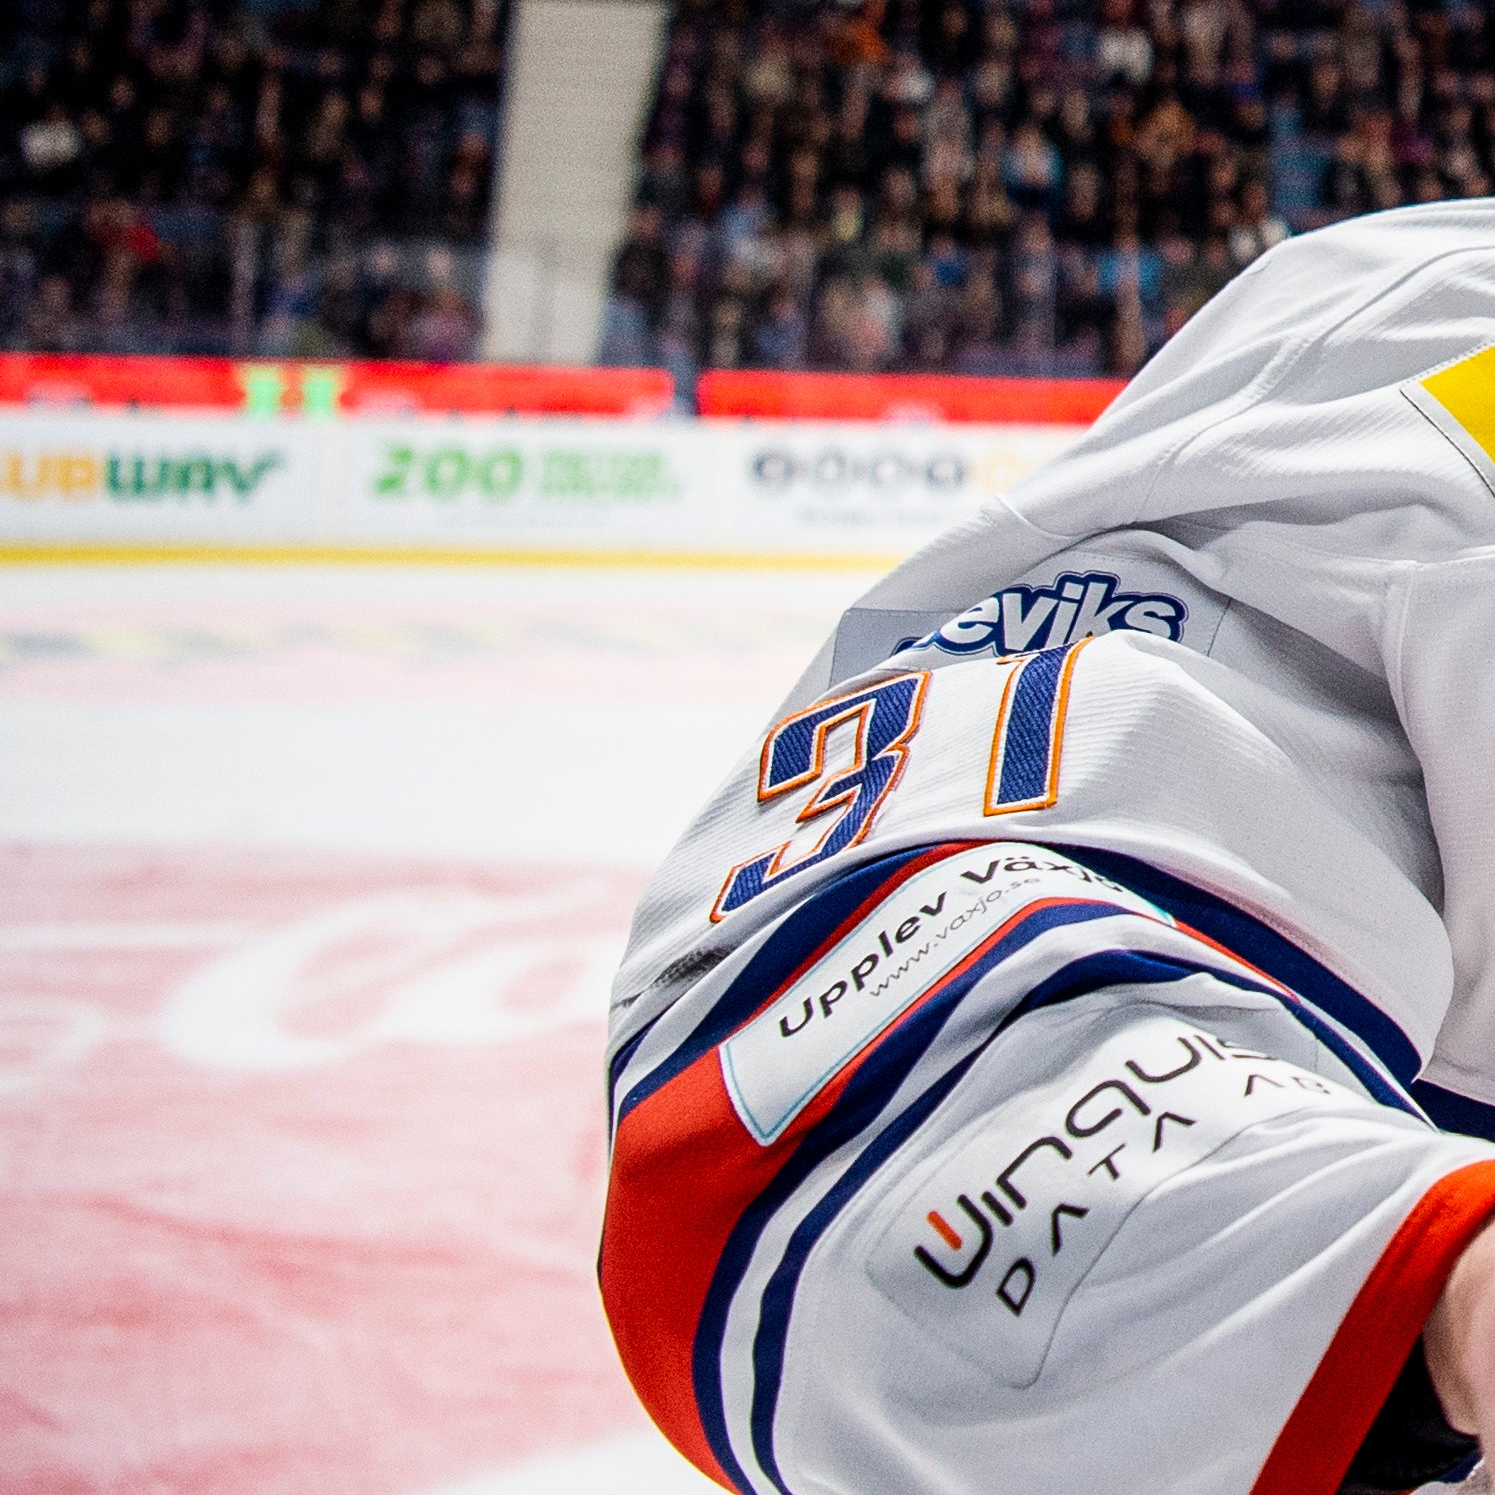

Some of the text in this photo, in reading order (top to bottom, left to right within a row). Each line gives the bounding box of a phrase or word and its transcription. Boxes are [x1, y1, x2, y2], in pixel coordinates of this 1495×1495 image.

[0, 447, 286, 505] UBWAY
[936, 578, 1176, 653] eviks
[709, 636, 1097, 924] 31
[778, 891, 948, 1039] Upplev
[869, 876, 1041, 999] www.vaxjo.se
[995, 1110, 1198, 1318] DATA
